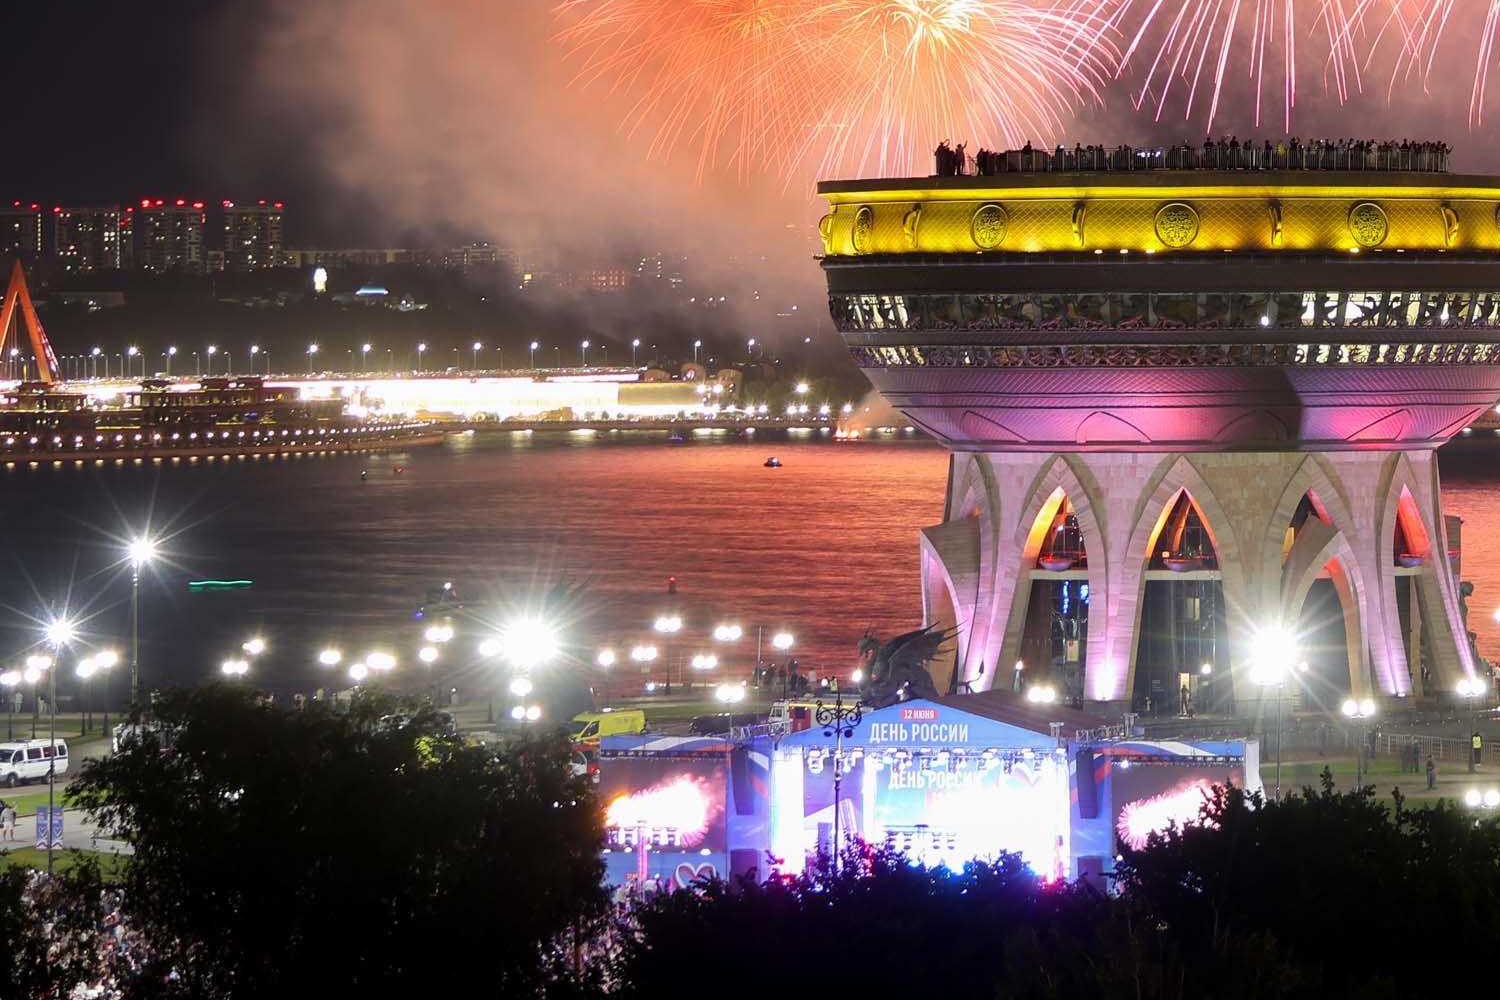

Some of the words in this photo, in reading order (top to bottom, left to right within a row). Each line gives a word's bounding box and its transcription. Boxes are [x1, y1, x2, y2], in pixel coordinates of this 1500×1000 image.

[904, 710, 912, 720] 12
[913, 710, 935, 720] ИЮНЯ
[870, 723, 908, 744] ДЕНЬ
[912, 723, 969, 742] РОССИИ
